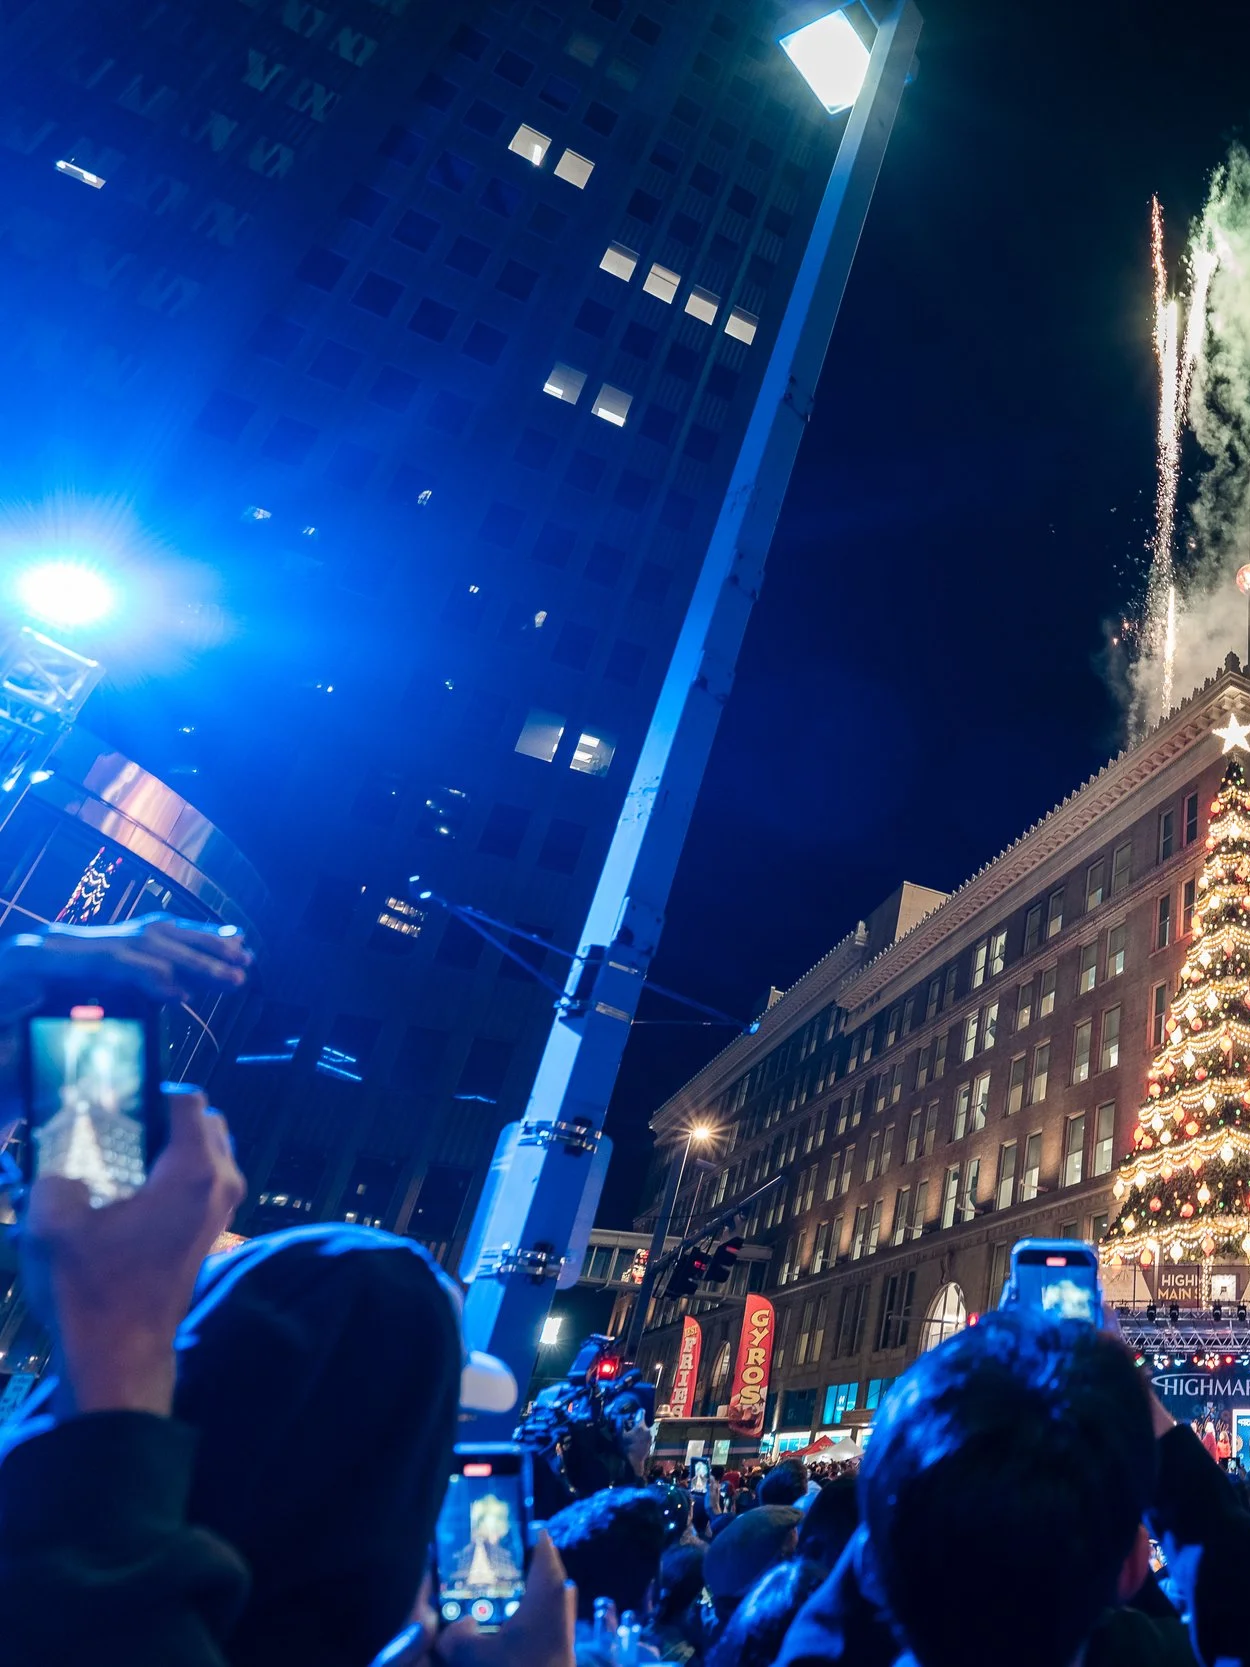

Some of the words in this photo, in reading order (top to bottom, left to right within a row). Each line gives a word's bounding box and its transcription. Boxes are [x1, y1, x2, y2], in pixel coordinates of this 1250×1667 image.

[1158, 1288, 1191, 1300] MAIN
[671, 1336, 697, 1417] FRIES
[739, 1309, 771, 1405] GYROS
